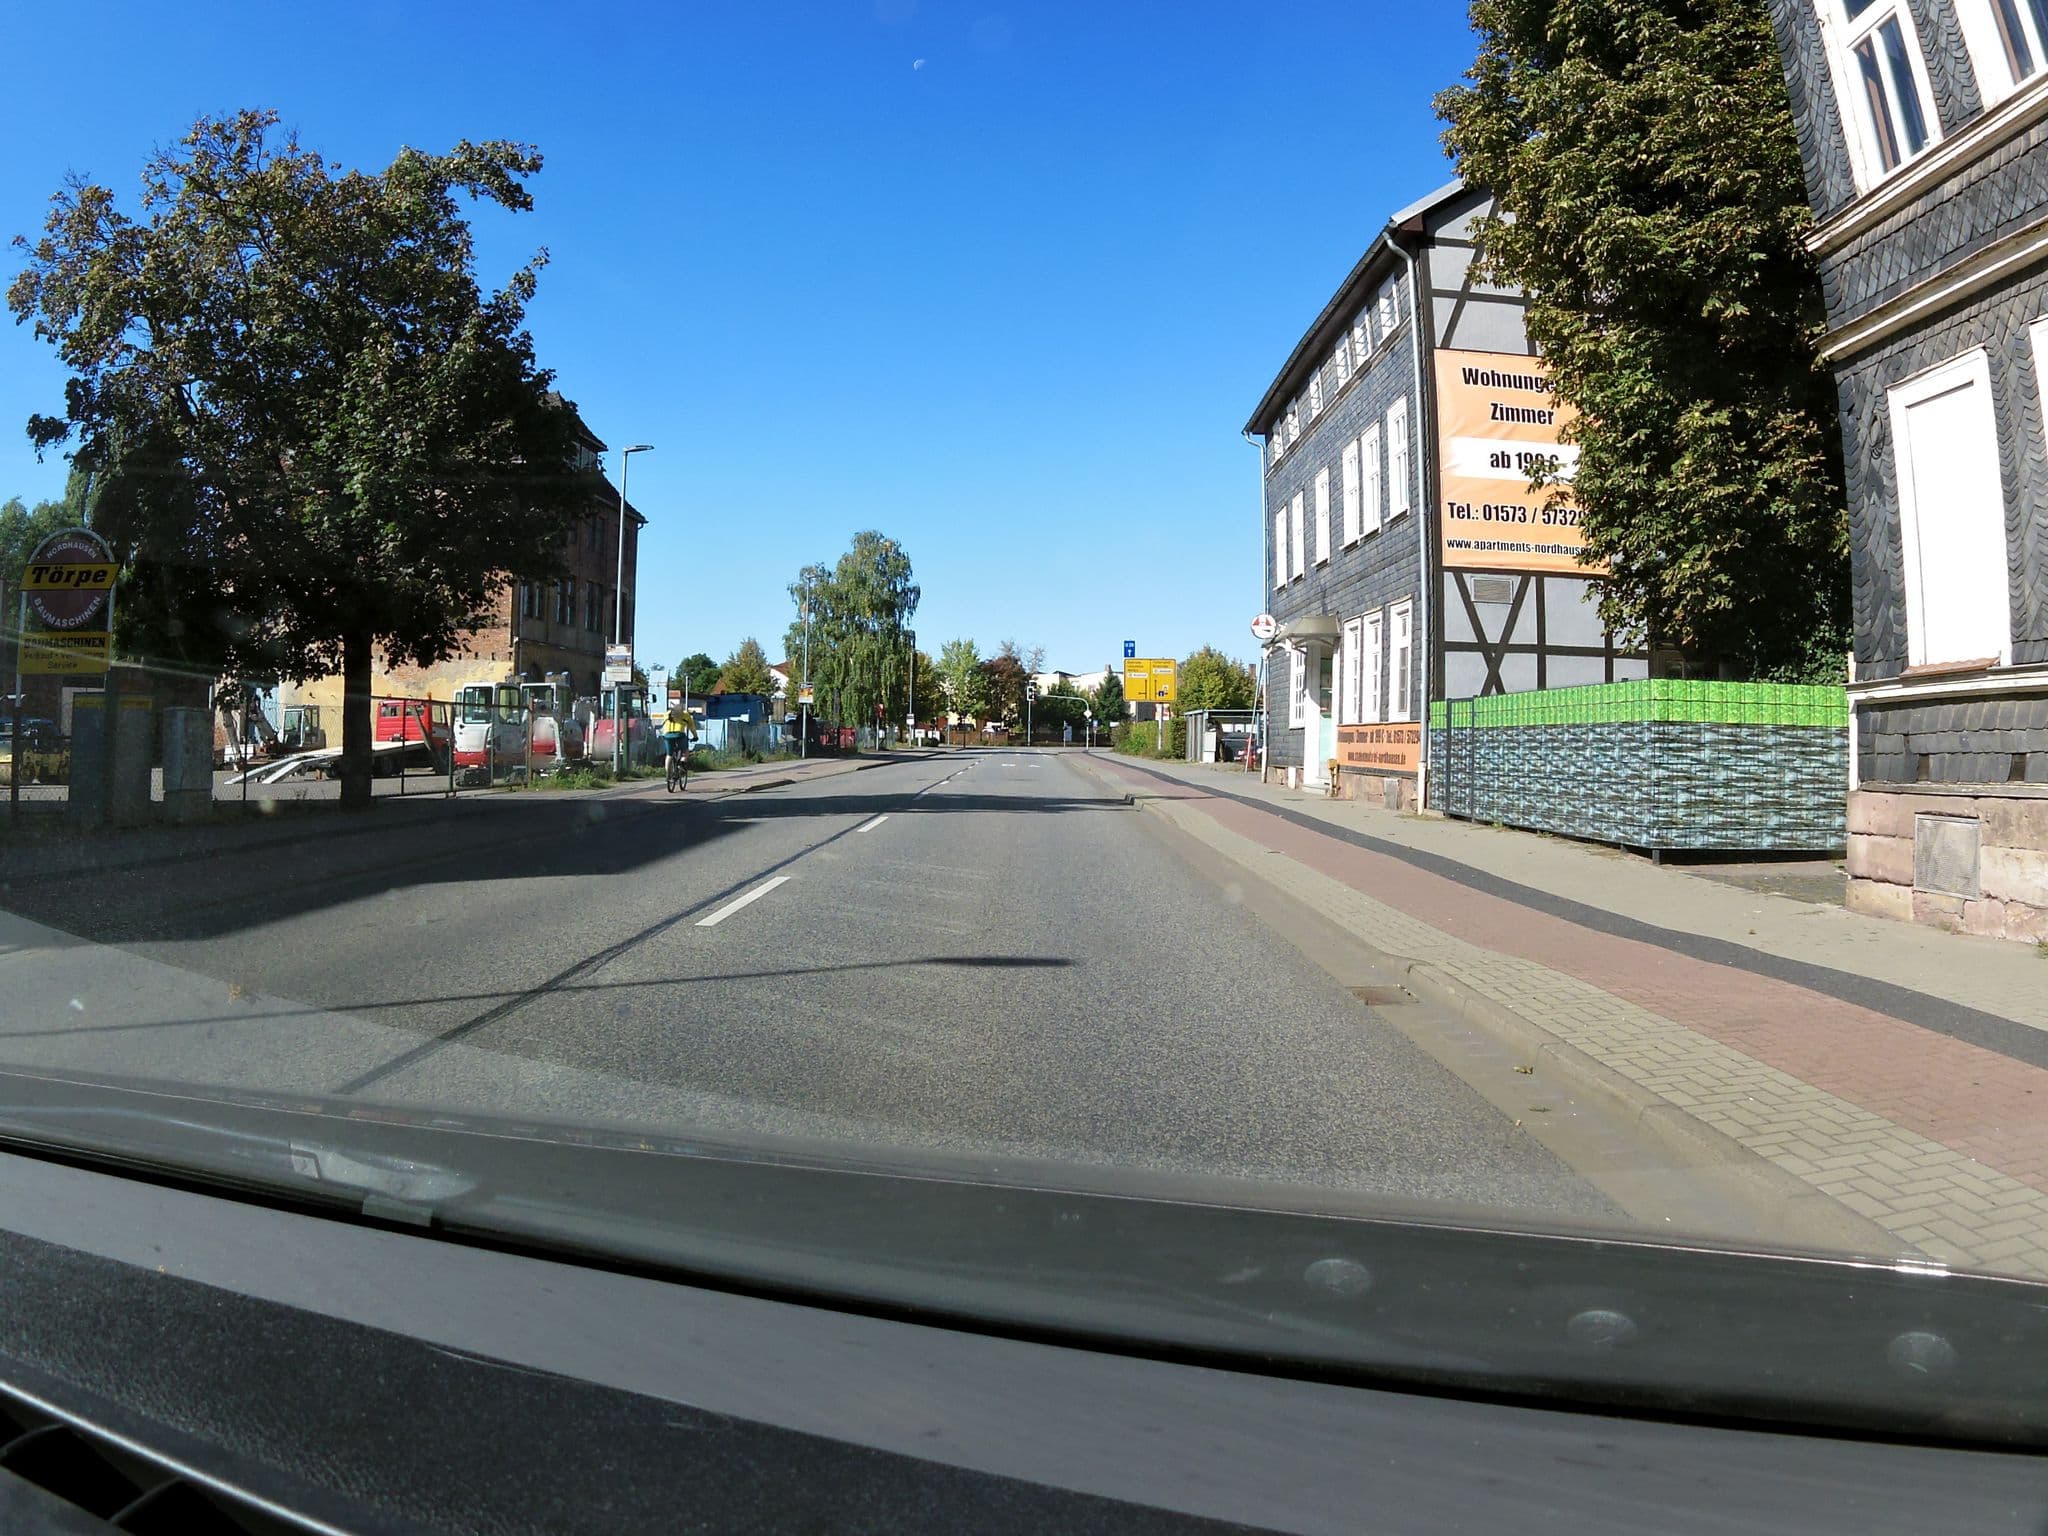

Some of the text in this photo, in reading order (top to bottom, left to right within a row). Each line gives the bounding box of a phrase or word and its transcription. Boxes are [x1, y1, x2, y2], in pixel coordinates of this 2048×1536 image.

[1491, 403, 1554, 425] Zimmer
[1490, 451, 1511, 469] ab
[1447, 502, 1479, 520] Tel.:
[1483, 504, 1527, 523] 01573
[1531, 507, 1538, 523] /
[31, 565, 108, 588] Törpe
[34, 596, 101, 627] BAUMASCHINEN
